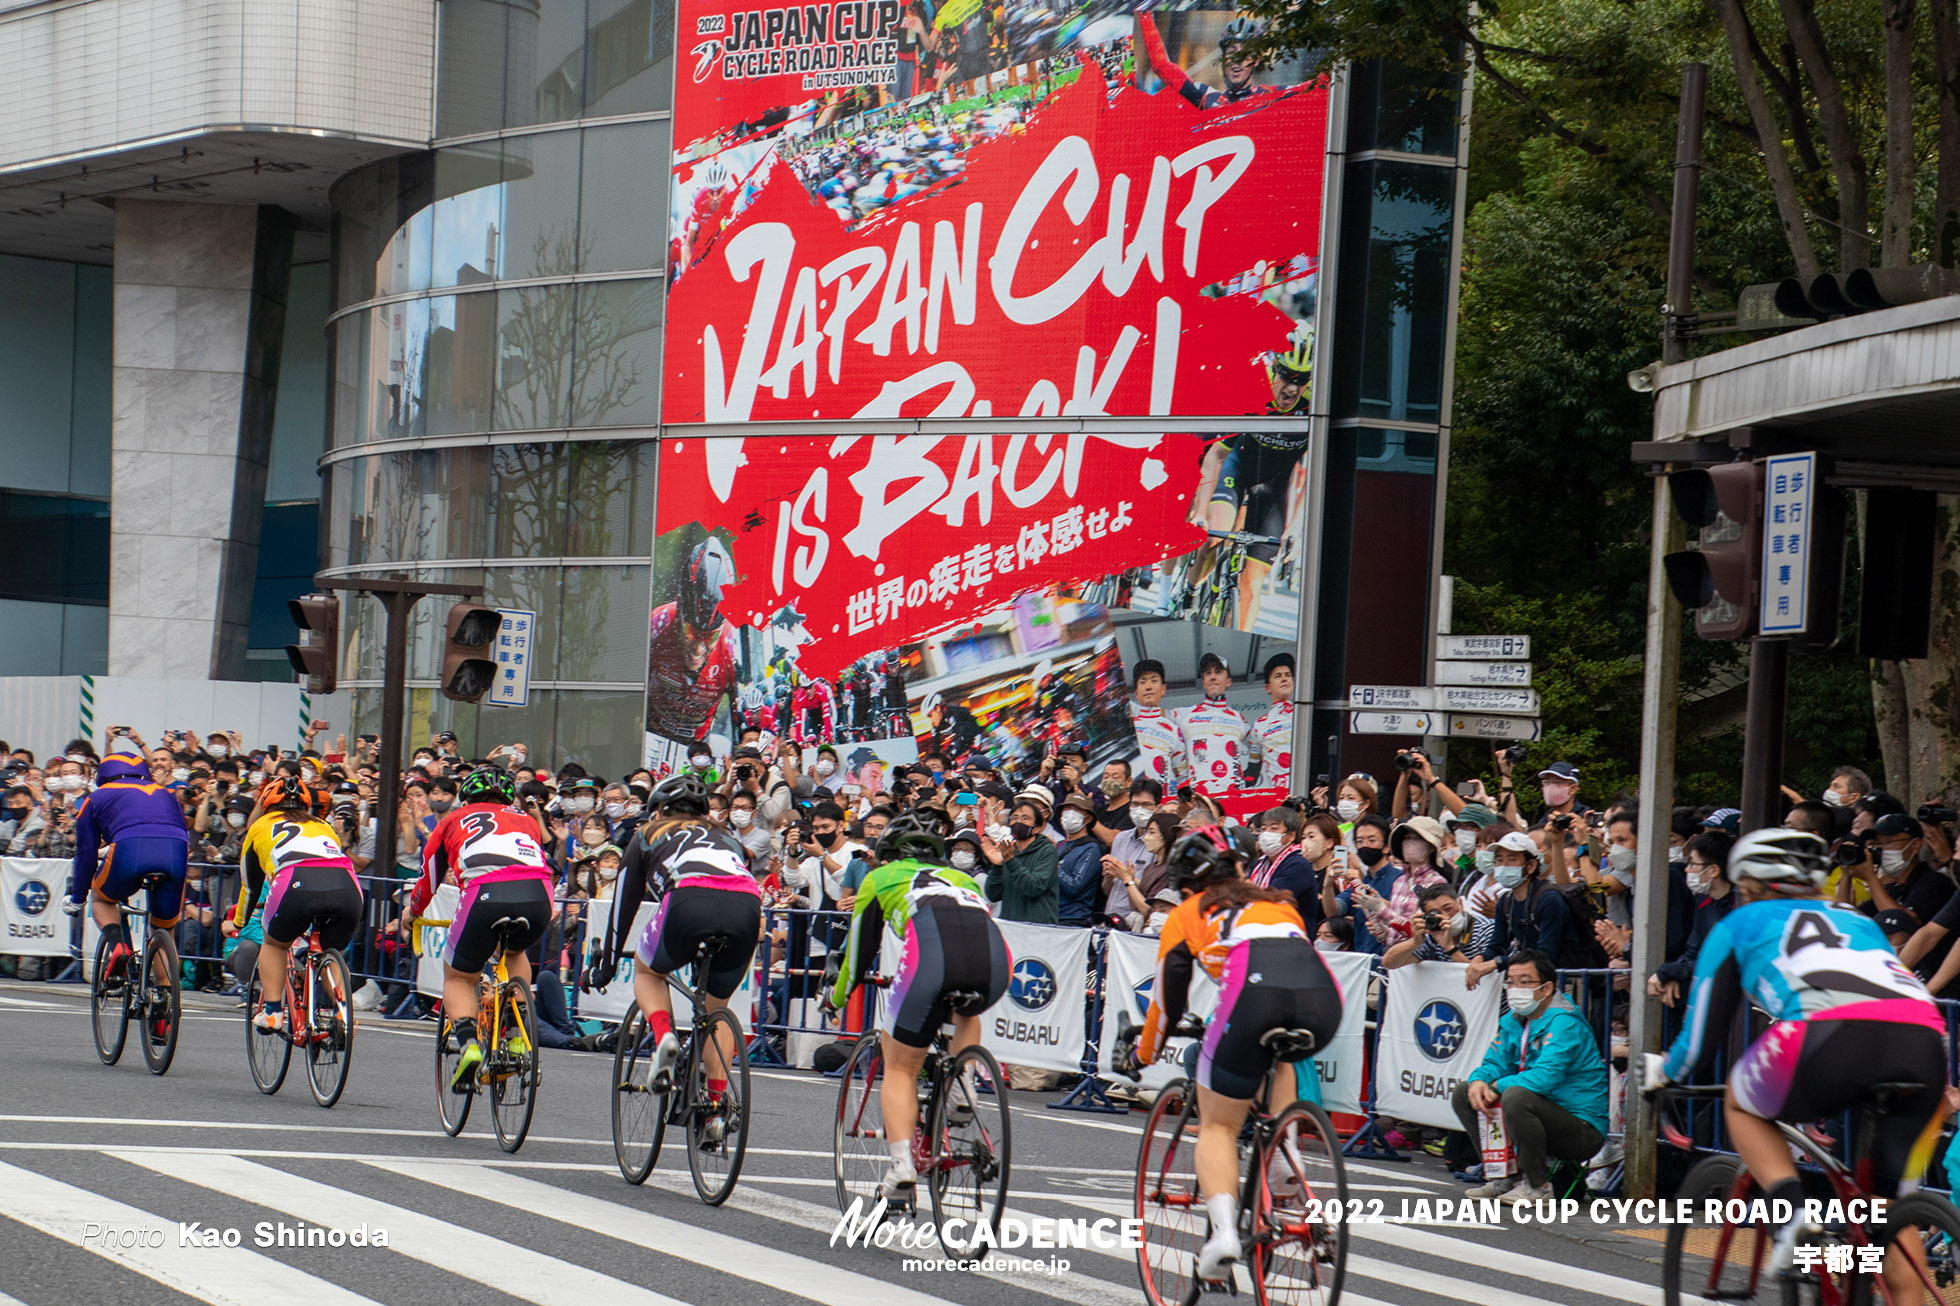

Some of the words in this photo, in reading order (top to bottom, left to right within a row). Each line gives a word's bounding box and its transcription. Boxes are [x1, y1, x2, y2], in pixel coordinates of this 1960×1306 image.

[698, 16, 724, 34] 2022
[724, 4, 831, 52] JAPAN
[833, 0, 900, 42] CUP
[723, 50, 782, 80] CYCLE
[783, 44, 842, 74] ROAD
[841, 39, 897, 69] RACE
[803, 75, 815, 91] in
[815, 68, 897, 89] UTSUNOMIYA
[703, 201, 982, 504] JAPAN
[989, 135, 1256, 325] CUP
[772, 467, 829, 596] IS
[830, 296, 1182, 561] BACK!
[1771, 473, 1787, 555] 自転車
[1787, 471, 1804, 555] 歩行者
[845, 500, 1134, 637] 世界の疾走を体感せよ
[1776, 564, 1792, 617] 専用
[498, 618, 513, 663] 自転車
[512, 619, 527, 665] 歩行者
[502, 668, 516, 698] 専用
[271, 820, 304, 851] 5
[460, 811, 498, 850] 3
[8, 922, 56, 939] SUBARU
[1782, 902, 1850, 958] 4
[993, 1016, 1061, 1046] SUBARU
[1400, 1069, 1461, 1101] SUBAR
